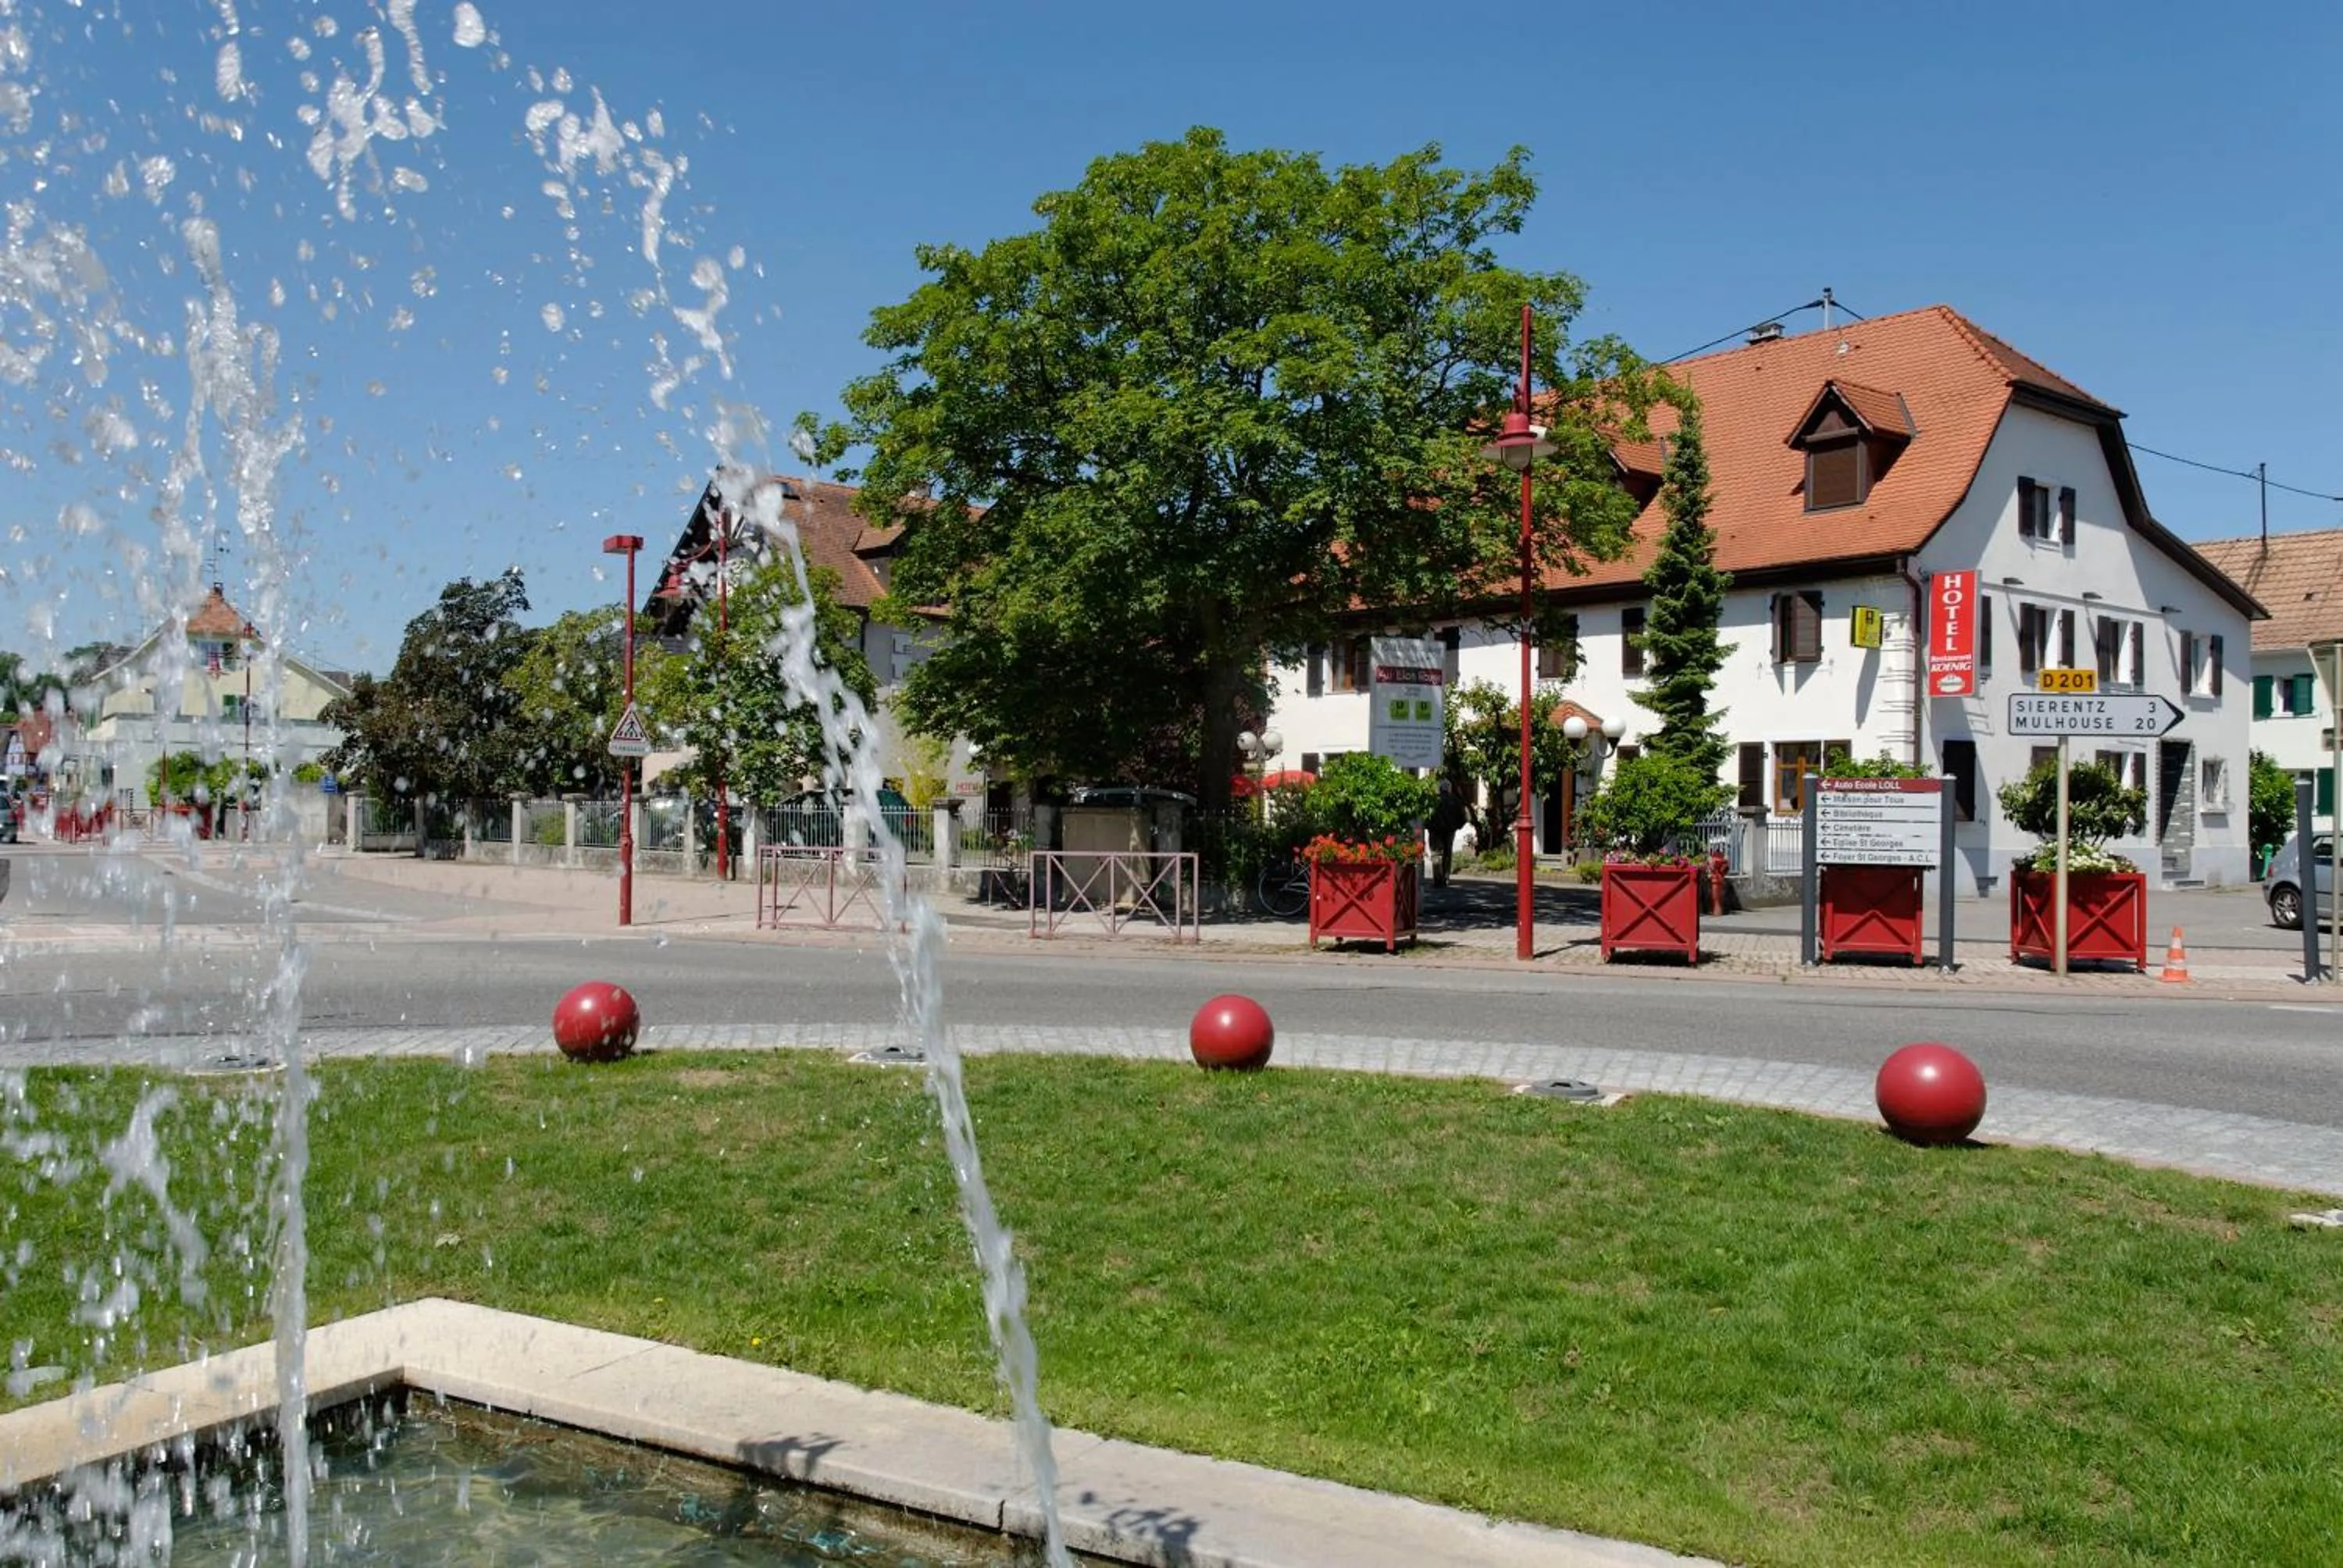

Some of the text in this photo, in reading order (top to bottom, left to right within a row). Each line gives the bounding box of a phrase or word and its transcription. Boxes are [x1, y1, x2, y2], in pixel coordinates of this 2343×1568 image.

[1942, 574, 1963, 650] HOTEL
[1931, 662, 1972, 672] KOENIG
[2043, 674, 2094, 687] D 201
[2016, 700, 2156, 714] SIERENTZ 3
[2016, 717, 2156, 730] MULHOUSE 20
[1855, 781, 1877, 789] Ecole
[1878, 781, 1901, 789] LOLL
[1870, 839, 1903, 848] Georges
[1833, 853, 1856, 862] Foyer
[1867, 853, 1902, 863] Georges
[1908, 854, 1933, 863] A.C.L.
